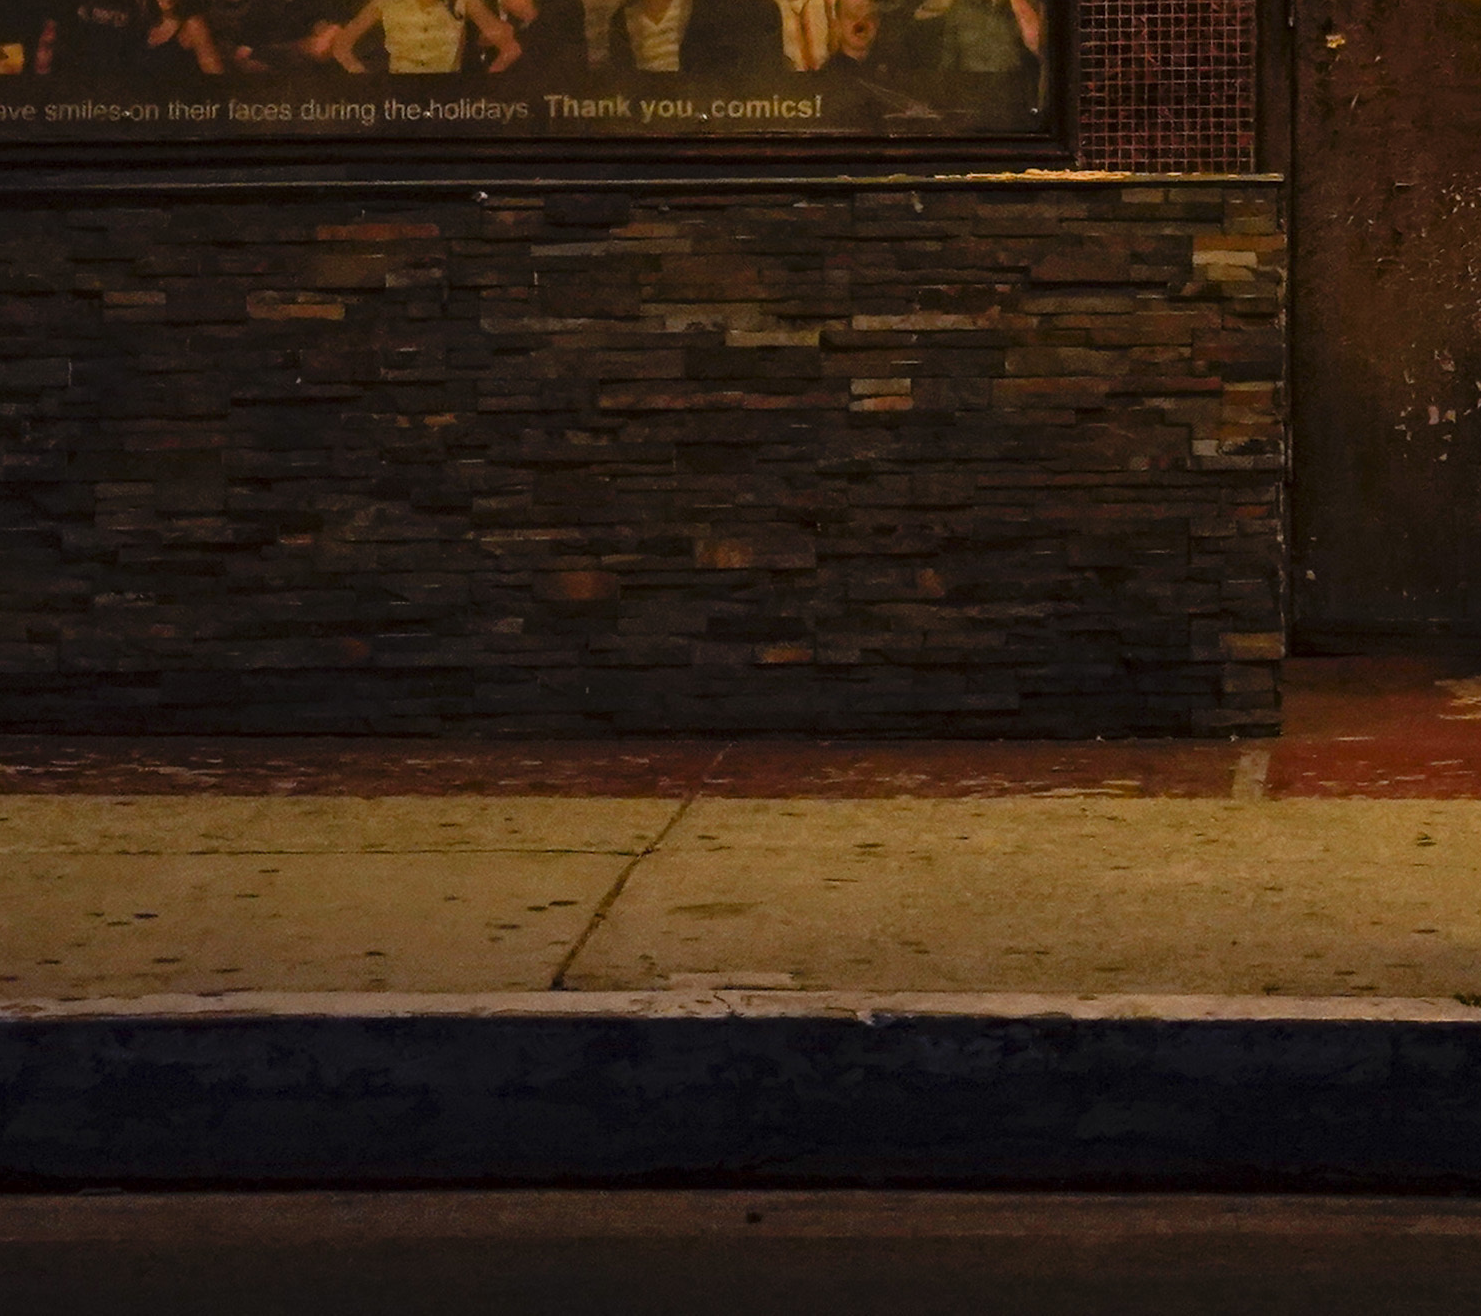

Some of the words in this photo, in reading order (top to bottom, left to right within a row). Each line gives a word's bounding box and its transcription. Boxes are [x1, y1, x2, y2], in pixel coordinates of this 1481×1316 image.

[44, 99, 119, 121] smiles
[130, 103, 159, 120] on
[167, 99, 220, 121] their
[228, 98, 292, 121] faces
[300, 98, 376, 127] during
[384, 97, 420, 120] the
[544, 94, 631, 119] Thank
[710, 93, 823, 119] comics!
